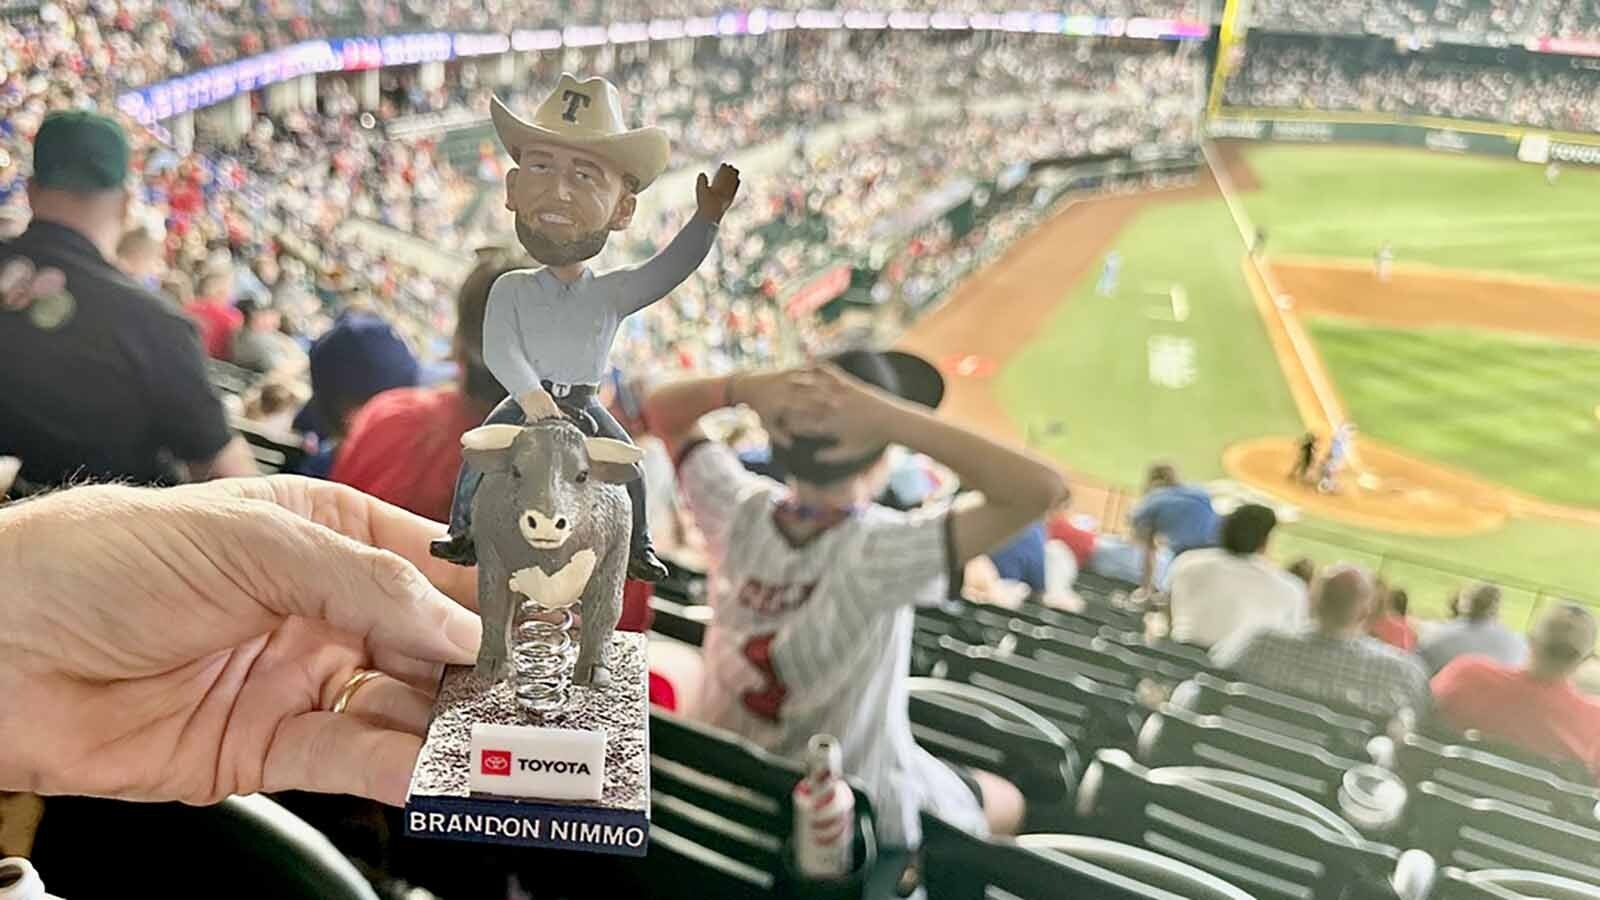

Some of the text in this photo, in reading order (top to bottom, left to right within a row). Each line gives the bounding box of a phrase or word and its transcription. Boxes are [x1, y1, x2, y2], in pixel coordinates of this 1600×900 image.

[563, 89, 591, 122] T
[518, 758, 590, 775] TOYOTA
[410, 811, 645, 848] BRANDON NIMMO
